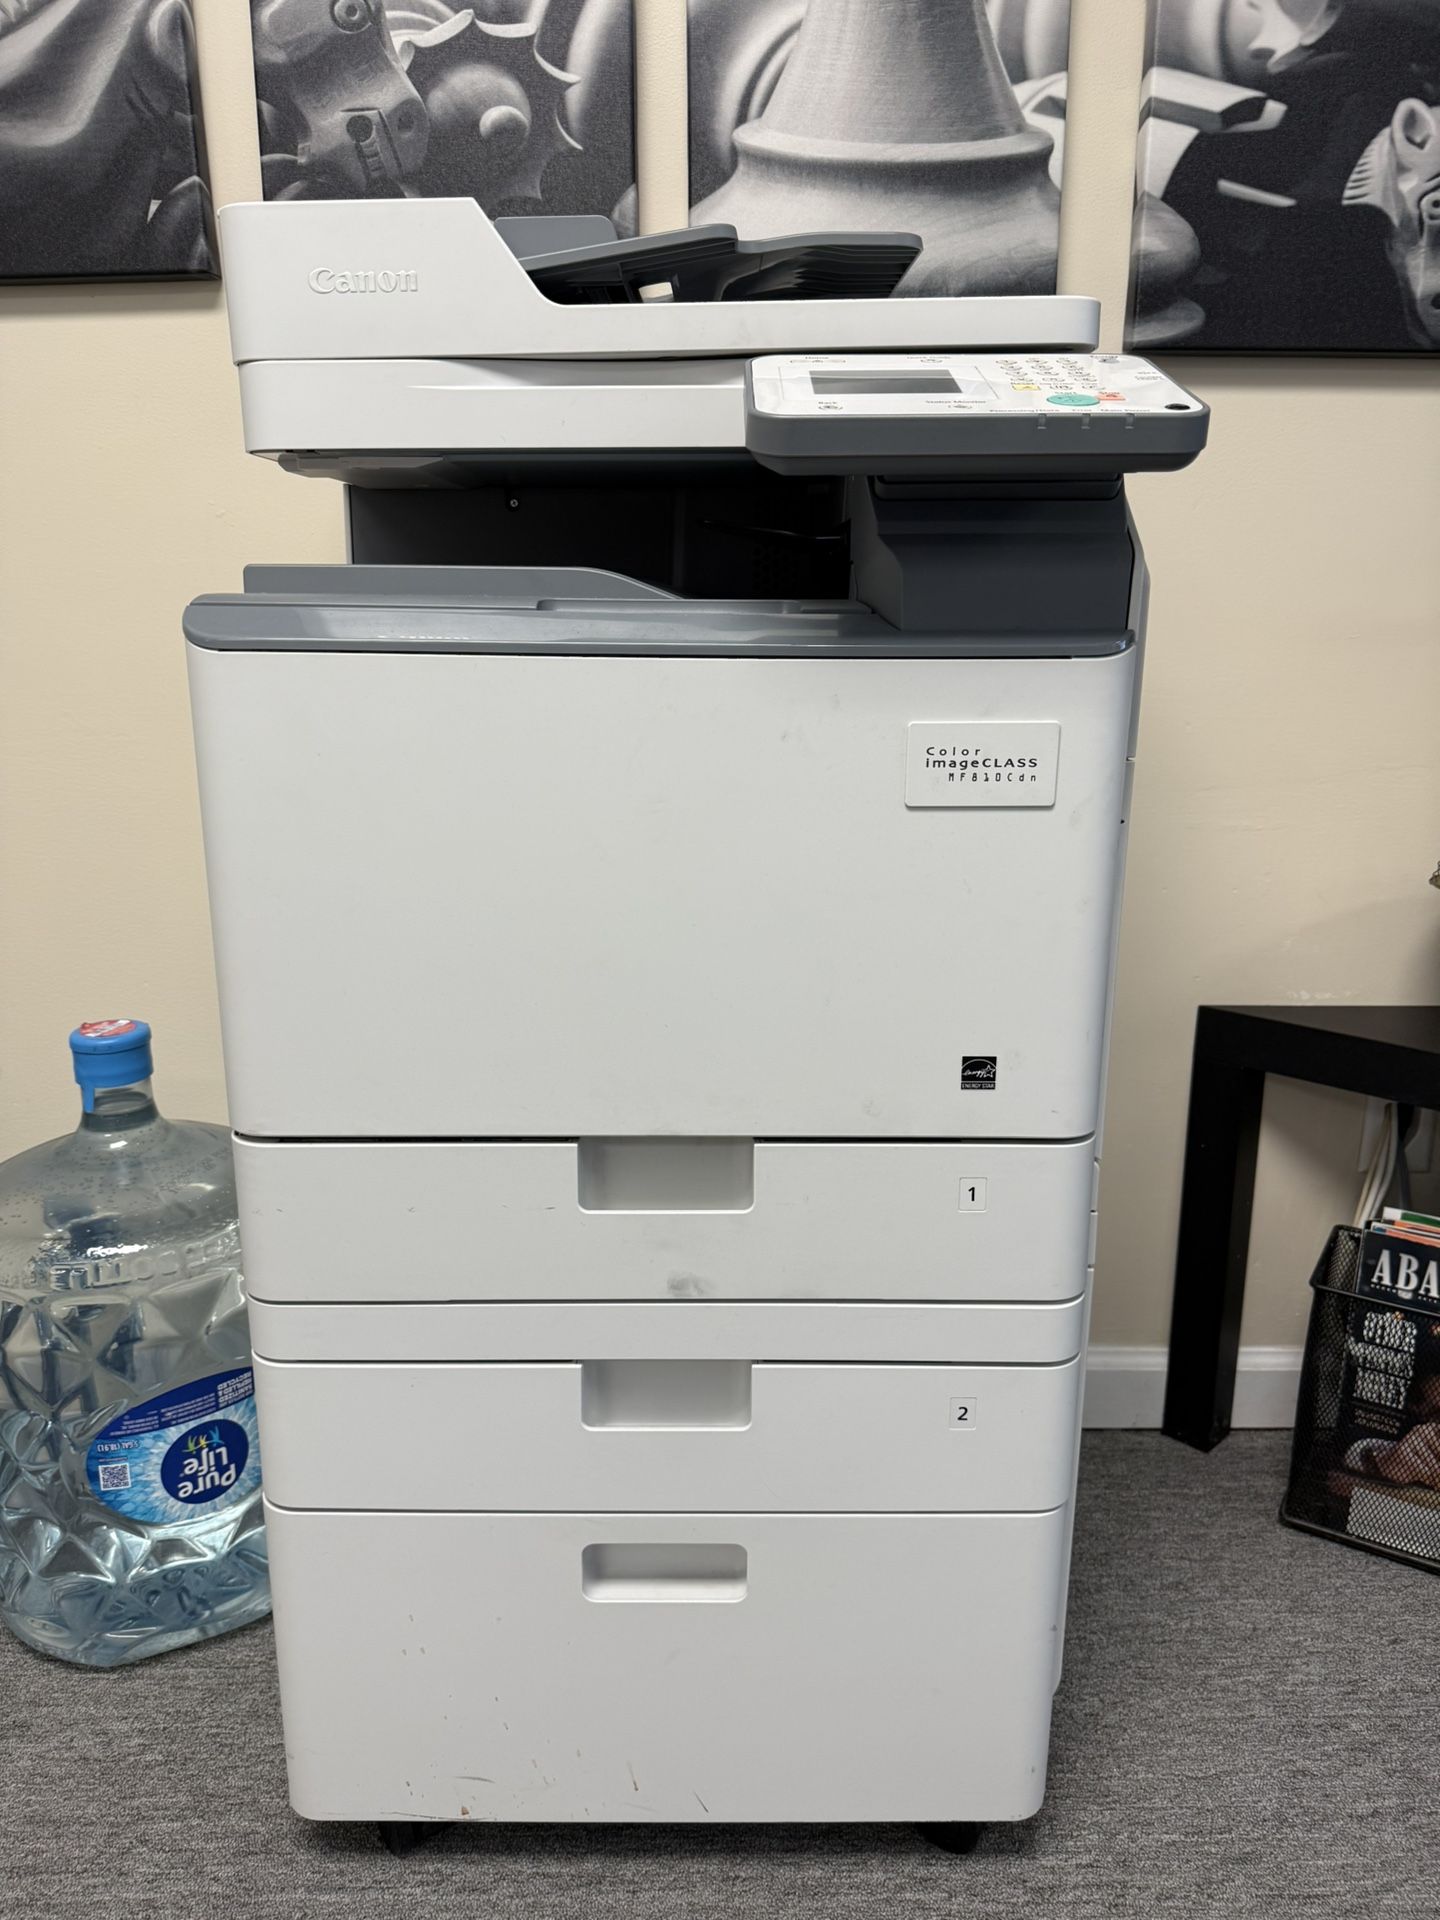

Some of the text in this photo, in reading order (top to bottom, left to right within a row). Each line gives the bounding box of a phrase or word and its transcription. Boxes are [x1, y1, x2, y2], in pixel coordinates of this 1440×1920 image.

[308, 267, 419, 294] Canon
[926, 746, 981, 756] Color
[925, 758, 1038, 770] imageCLASS
[948, 772, 1037, 782] MF810Cdn
[968, 1186, 976, 1201] 1
[1371, 1249, 1440, 1298] ABA
[957, 1406, 969, 1421] 2
[183, 1446, 229, 1475] Life
[177, 1463, 236, 1499] Pure
